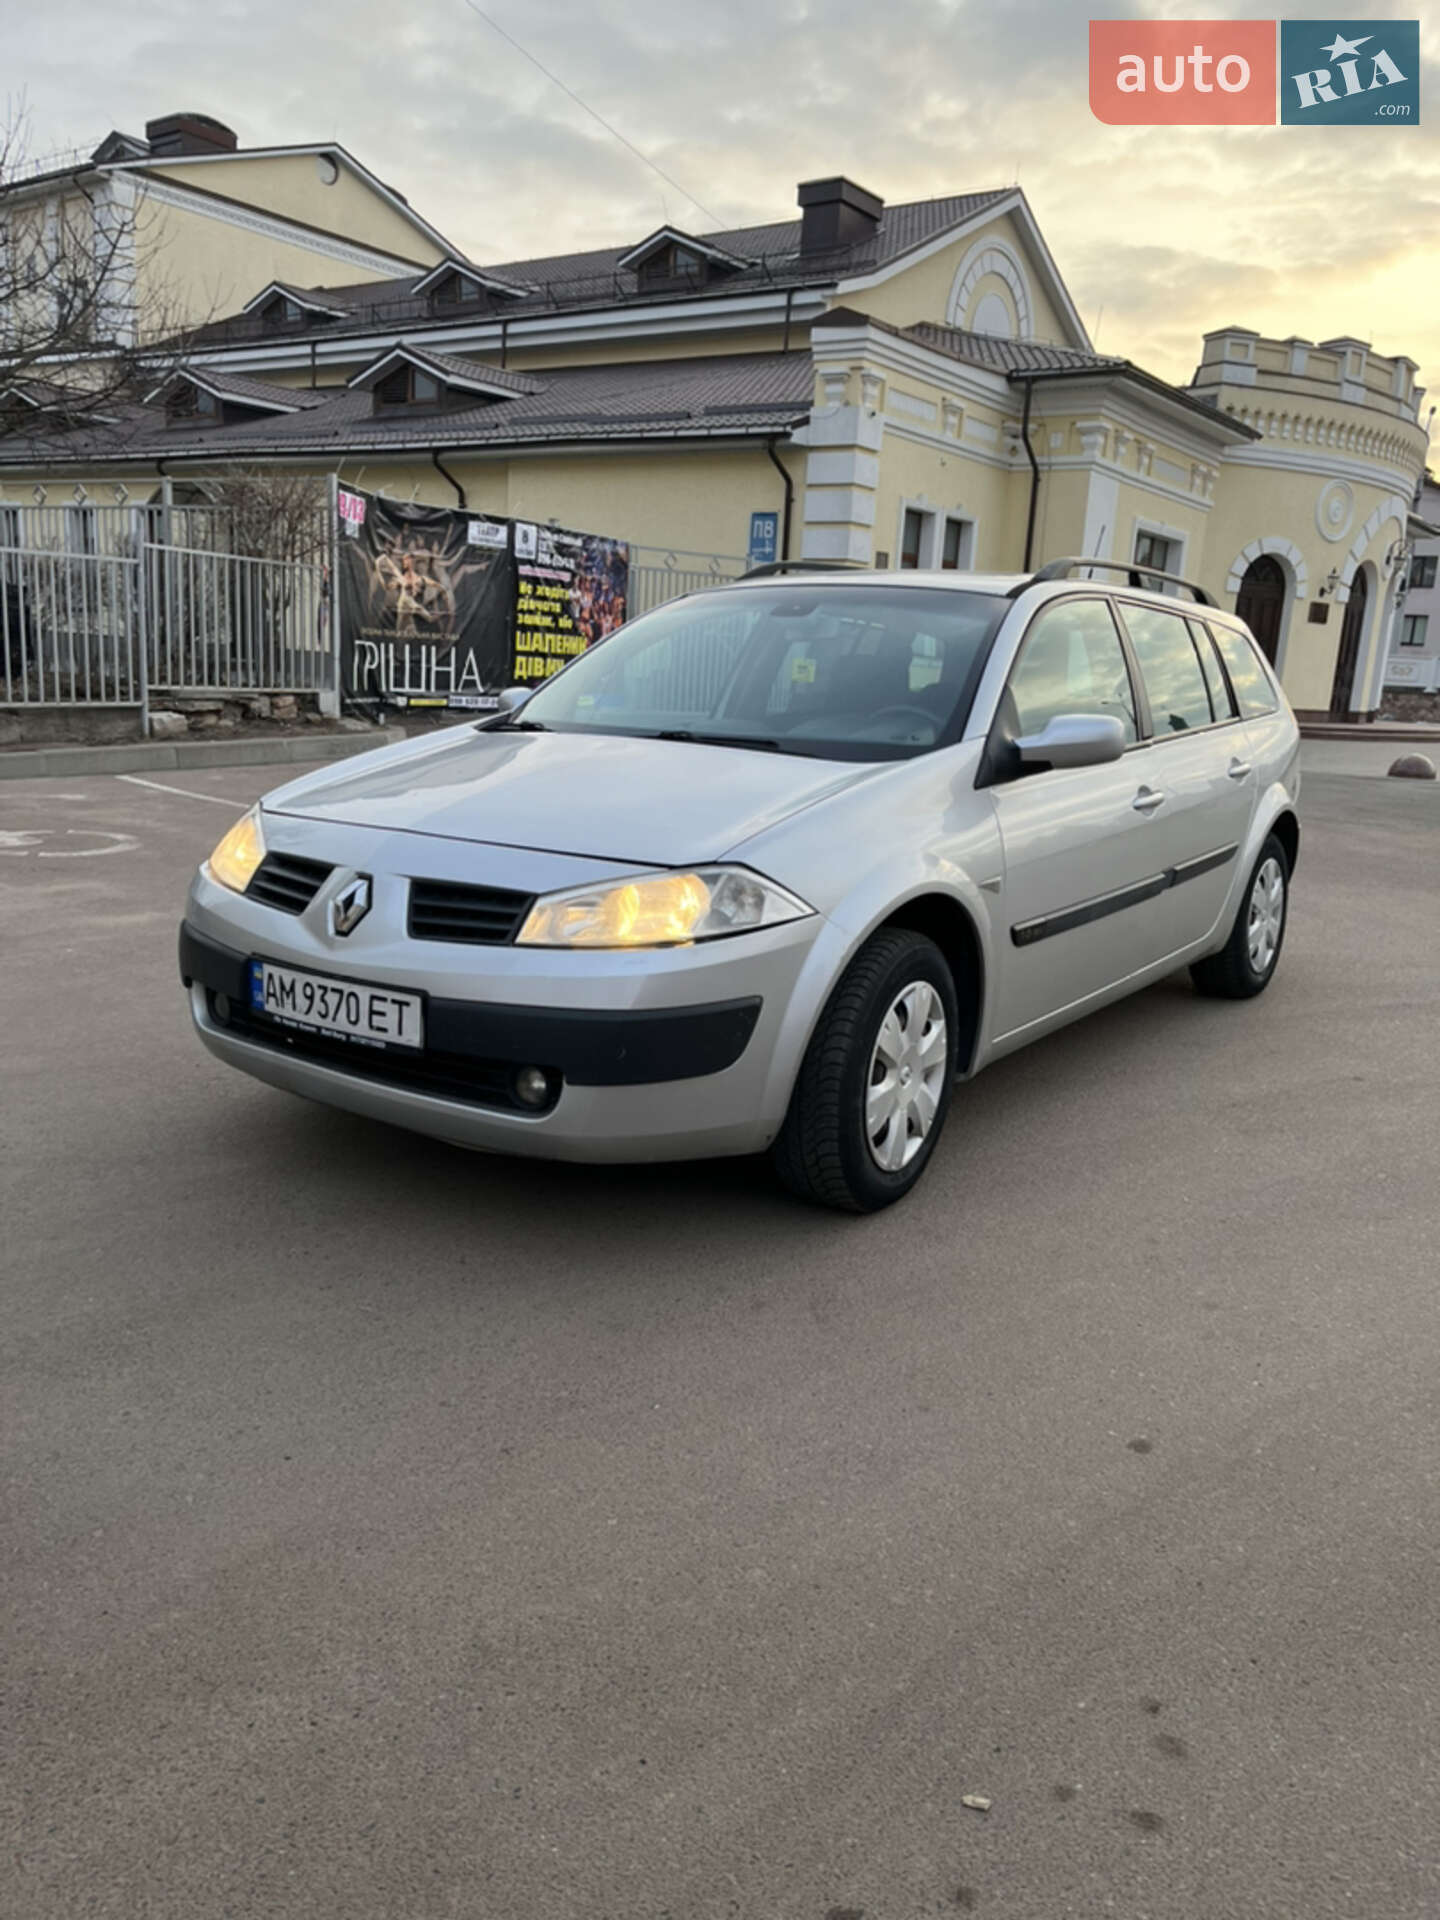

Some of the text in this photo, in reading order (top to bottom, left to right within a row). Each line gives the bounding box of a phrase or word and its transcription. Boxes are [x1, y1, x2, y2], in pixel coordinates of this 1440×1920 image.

[353, 640, 485, 693] ГРІШНА
[265, 972, 297, 1012] AM
[302, 981, 361, 1026] 9370
[368, 993, 411, 1037] ET
